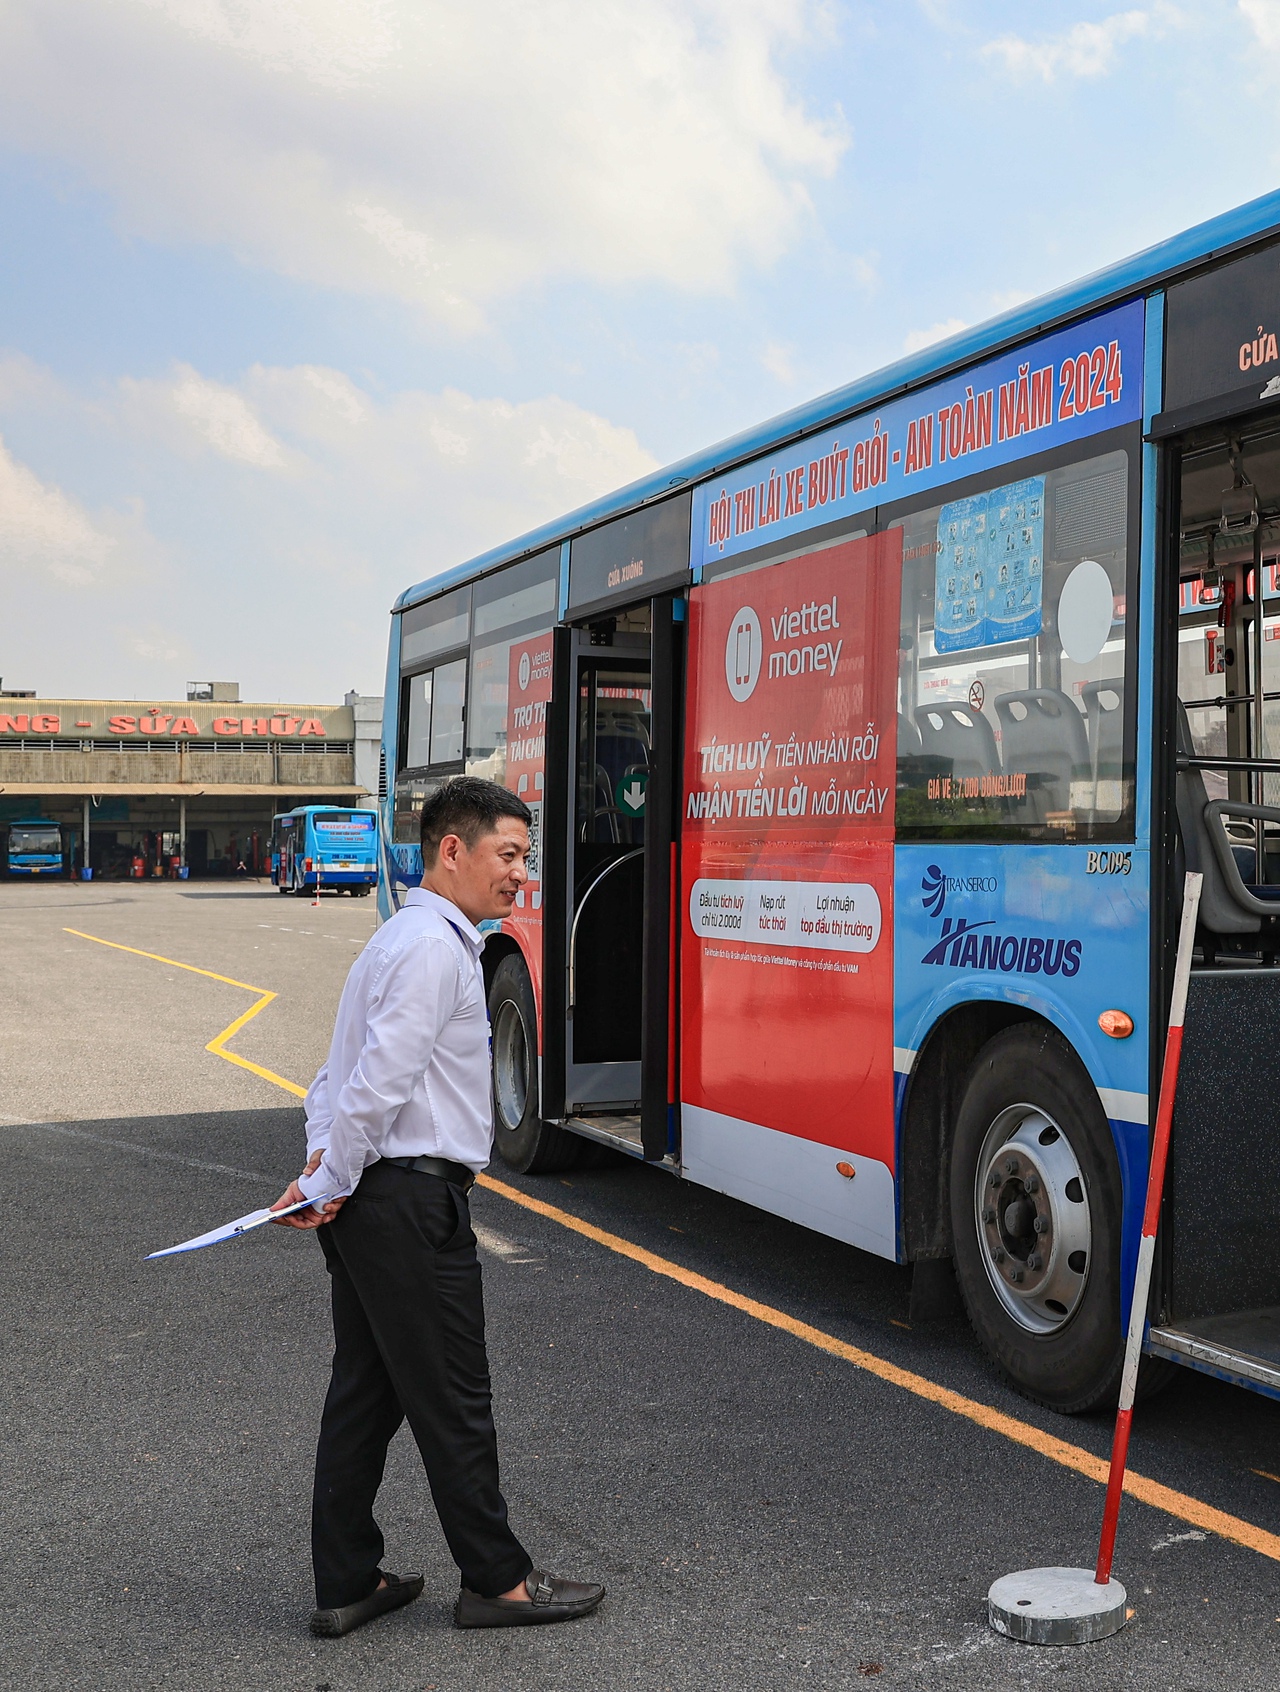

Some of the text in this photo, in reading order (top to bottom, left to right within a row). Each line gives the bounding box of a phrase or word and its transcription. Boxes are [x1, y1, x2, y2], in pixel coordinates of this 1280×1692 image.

[1239, 325, 1279, 371] CỬA
[708, 489, 731, 552] HỘI
[735, 486, 756, 535] THI
[758, 467, 781, 528] LÁI
[784, 466, 804, 519] XE
[807, 441, 849, 510] BUÝT
[852, 418, 889, 494] GIỎI
[904, 413, 934, 476] AN
[938, 385, 993, 464] TOÀN
[998, 361, 1053, 443] NĂM
[1058, 340, 1122, 422] 2024
[771, 596, 840, 641] viettel
[532, 649, 552, 666] viettel
[769, 640, 843, 679] money
[532, 665, 552, 680] money
[108, 708, 199, 735] SỬA
[213, 712, 326, 737] CHỮA
[514, 701, 546, 730] TRỢ TH
[511, 730, 545, 762] TÀI CHÍN
[701, 722, 879, 773] TÍCH LUỸ TIỀN NHÀN RỖI
[687, 771, 889, 824] NHẬN TIỀN LỜI MỖI NGÀY
[928, 774, 940, 799] GIÁ
[942, 773, 951, 798] VÉ
[957, 777, 979, 798] 7.000
[1085, 851, 1132, 875] BC095
[945, 876, 997, 892] TRANSERCO
[700, 891, 712, 907] Đầu
[720, 893, 732, 908] tích
[760, 894, 786, 911] Nạp rút
[816, 895, 855, 914] Lợi nhuận
[759, 914, 786, 931] tức thời
[801, 915, 873, 941] top đầu thị trường
[921, 918, 1082, 977] HANOIBUS
